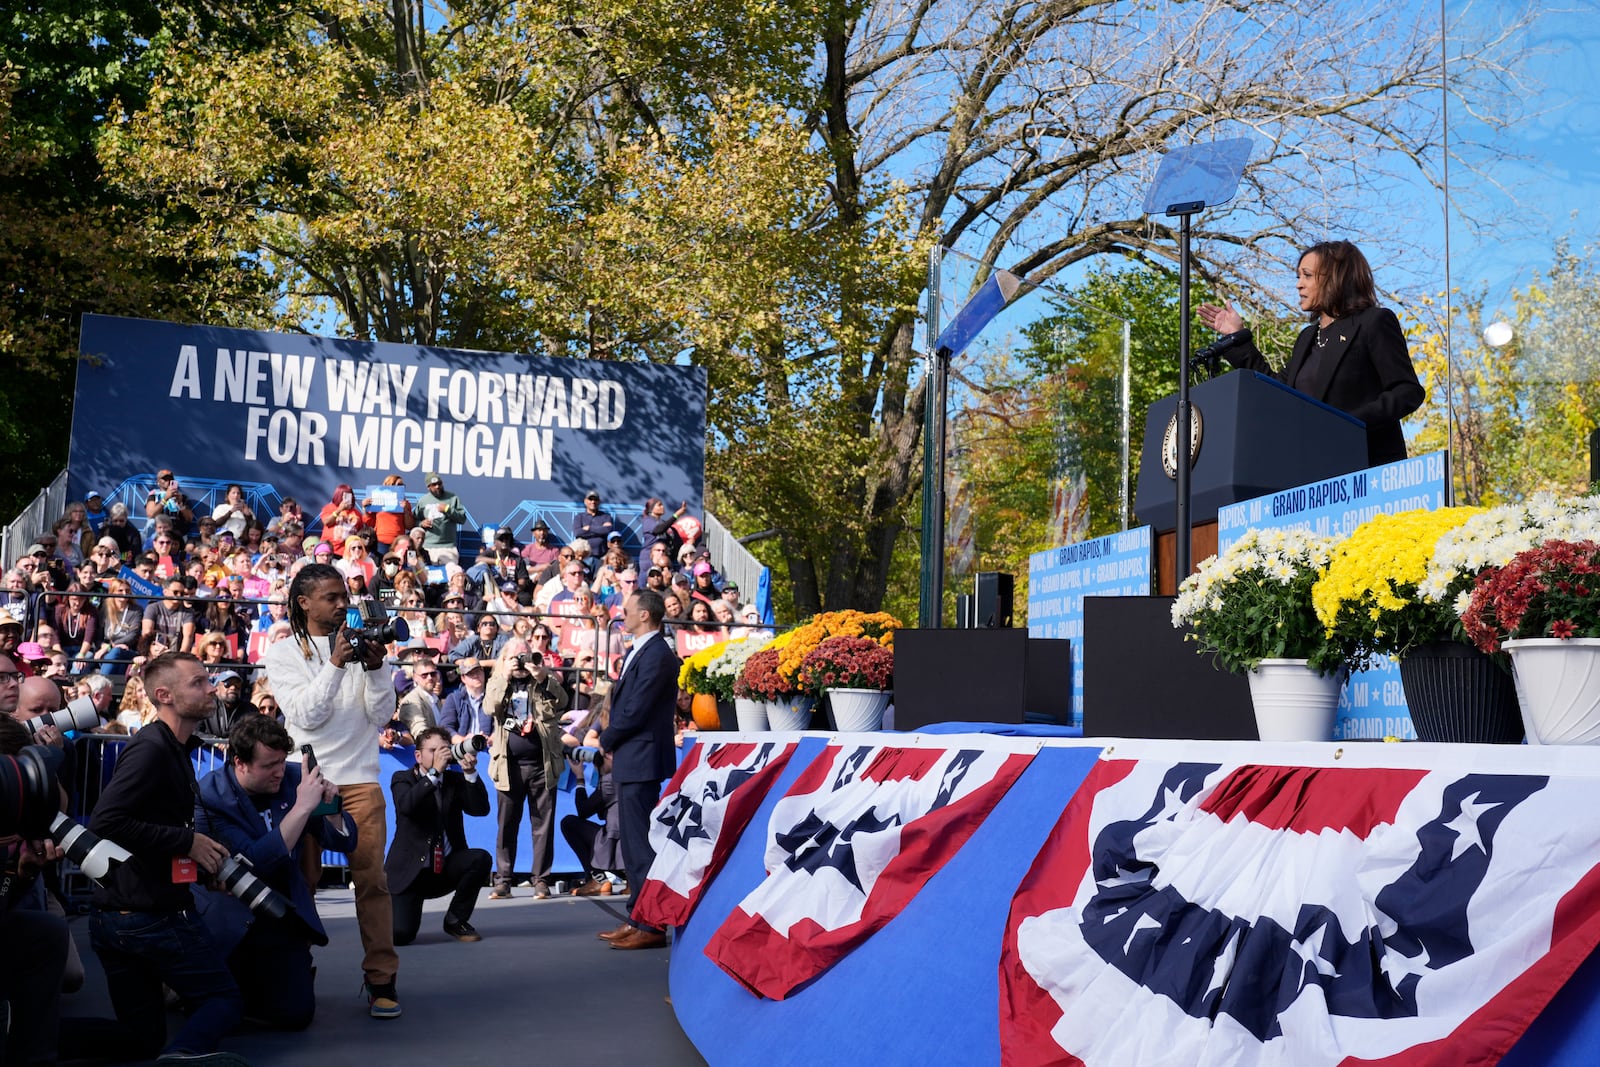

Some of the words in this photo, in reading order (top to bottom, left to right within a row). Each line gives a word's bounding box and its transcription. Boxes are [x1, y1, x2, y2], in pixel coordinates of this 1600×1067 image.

[169, 345, 201, 400] A
[214, 348, 316, 409] NEW
[325, 359, 419, 417] WAY
[428, 370, 626, 431] FORWARD
[245, 406, 328, 466] FOR
[338, 415, 553, 481] MICHIGAN
[1249, 500, 1261, 523] MI
[1272, 489, 1306, 518] GRAND
[1308, 478, 1351, 510] RAPIDS,
[1353, 473, 1367, 499] MI
[1381, 461, 1424, 493] GRAND
[1316, 516, 1329, 538] MI
[1059, 546, 1079, 565] GRAND
[1079, 540, 1102, 561] RAPIDS,
[1103, 538, 1111, 556] MI
[1118, 530, 1141, 552] GRAND
[122, 572, 153, 597] LATINOS
[1083, 567, 1091, 586] MI
[1097, 562, 1118, 583] GRAND
[1119, 556, 1144, 579] RAPIDS,
[685, 633, 715, 650] USA
[1354, 682, 1368, 707] MI
[1343, 717, 1383, 740] GRAND
